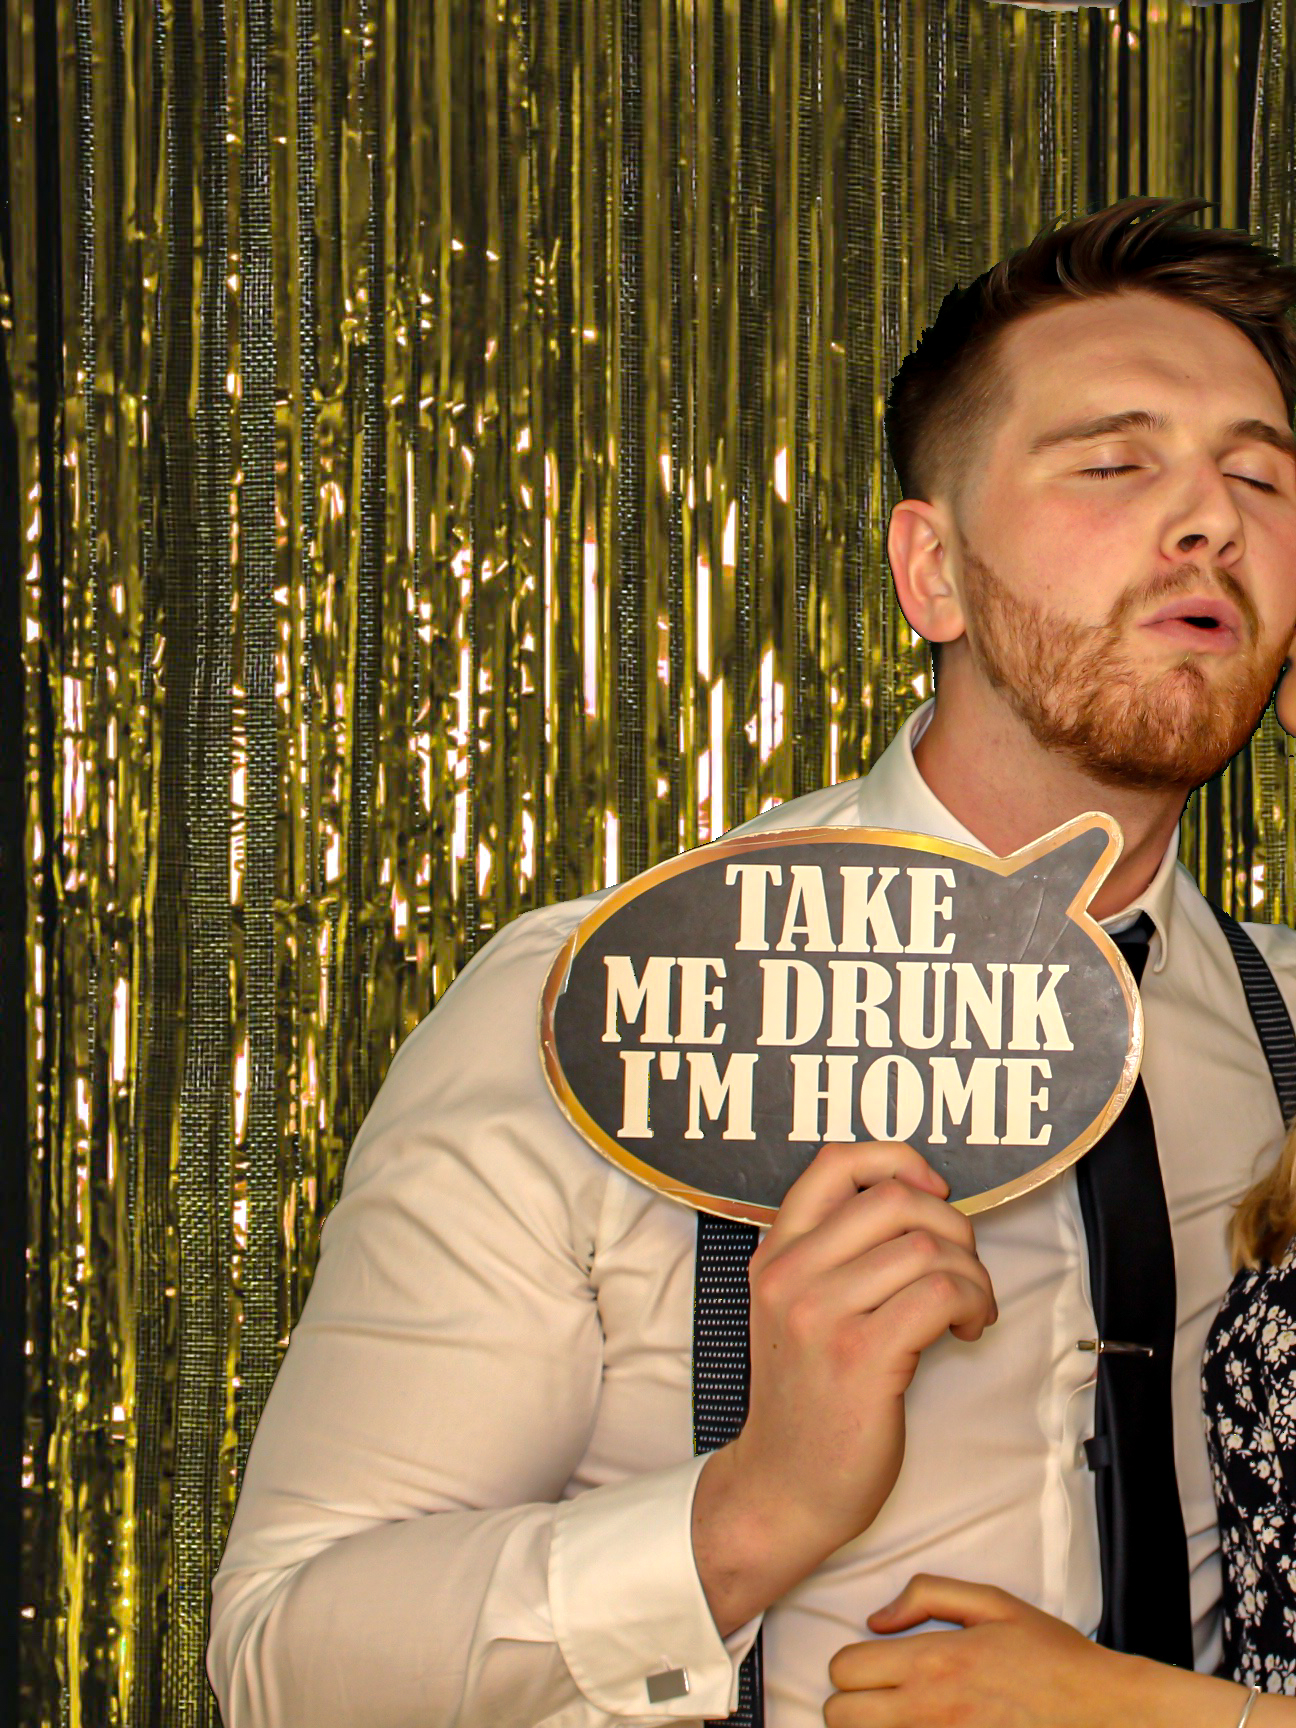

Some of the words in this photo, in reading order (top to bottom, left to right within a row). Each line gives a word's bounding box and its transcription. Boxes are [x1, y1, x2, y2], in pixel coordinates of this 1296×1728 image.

[725, 863, 957, 955] TAKE
[601, 955, 728, 1045] ME
[755, 958, 1075, 1052] DRUNK
[616, 1050, 760, 1141] I'M
[787, 1053, 1053, 1147] HOME
